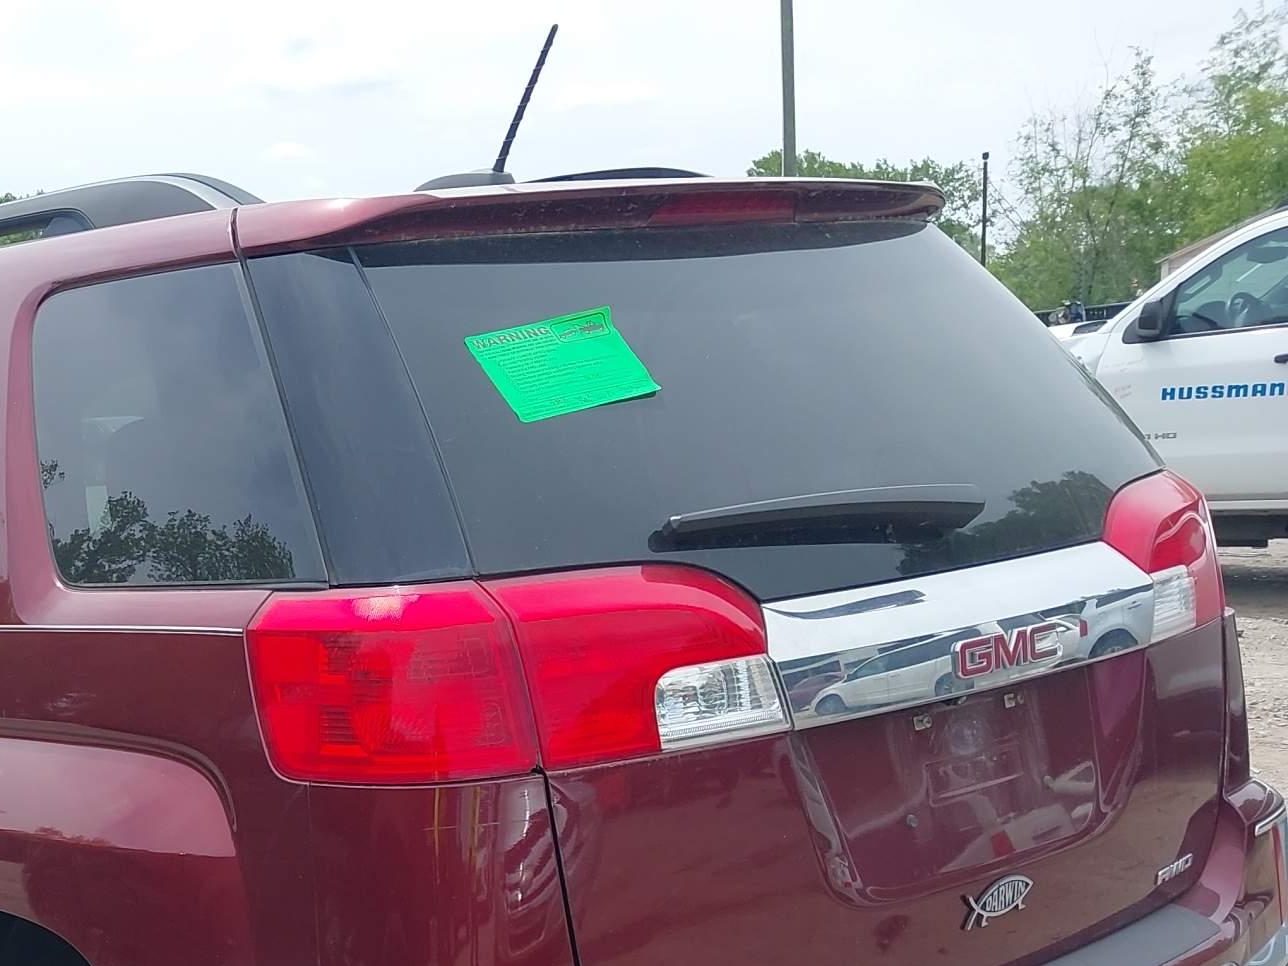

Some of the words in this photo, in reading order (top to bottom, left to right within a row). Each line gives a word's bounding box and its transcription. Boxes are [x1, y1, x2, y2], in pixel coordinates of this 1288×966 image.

[473, 326, 552, 349] WARNING
[954, 620, 1062, 679] GMC
[985, 880, 1026, 912] DARWIN
